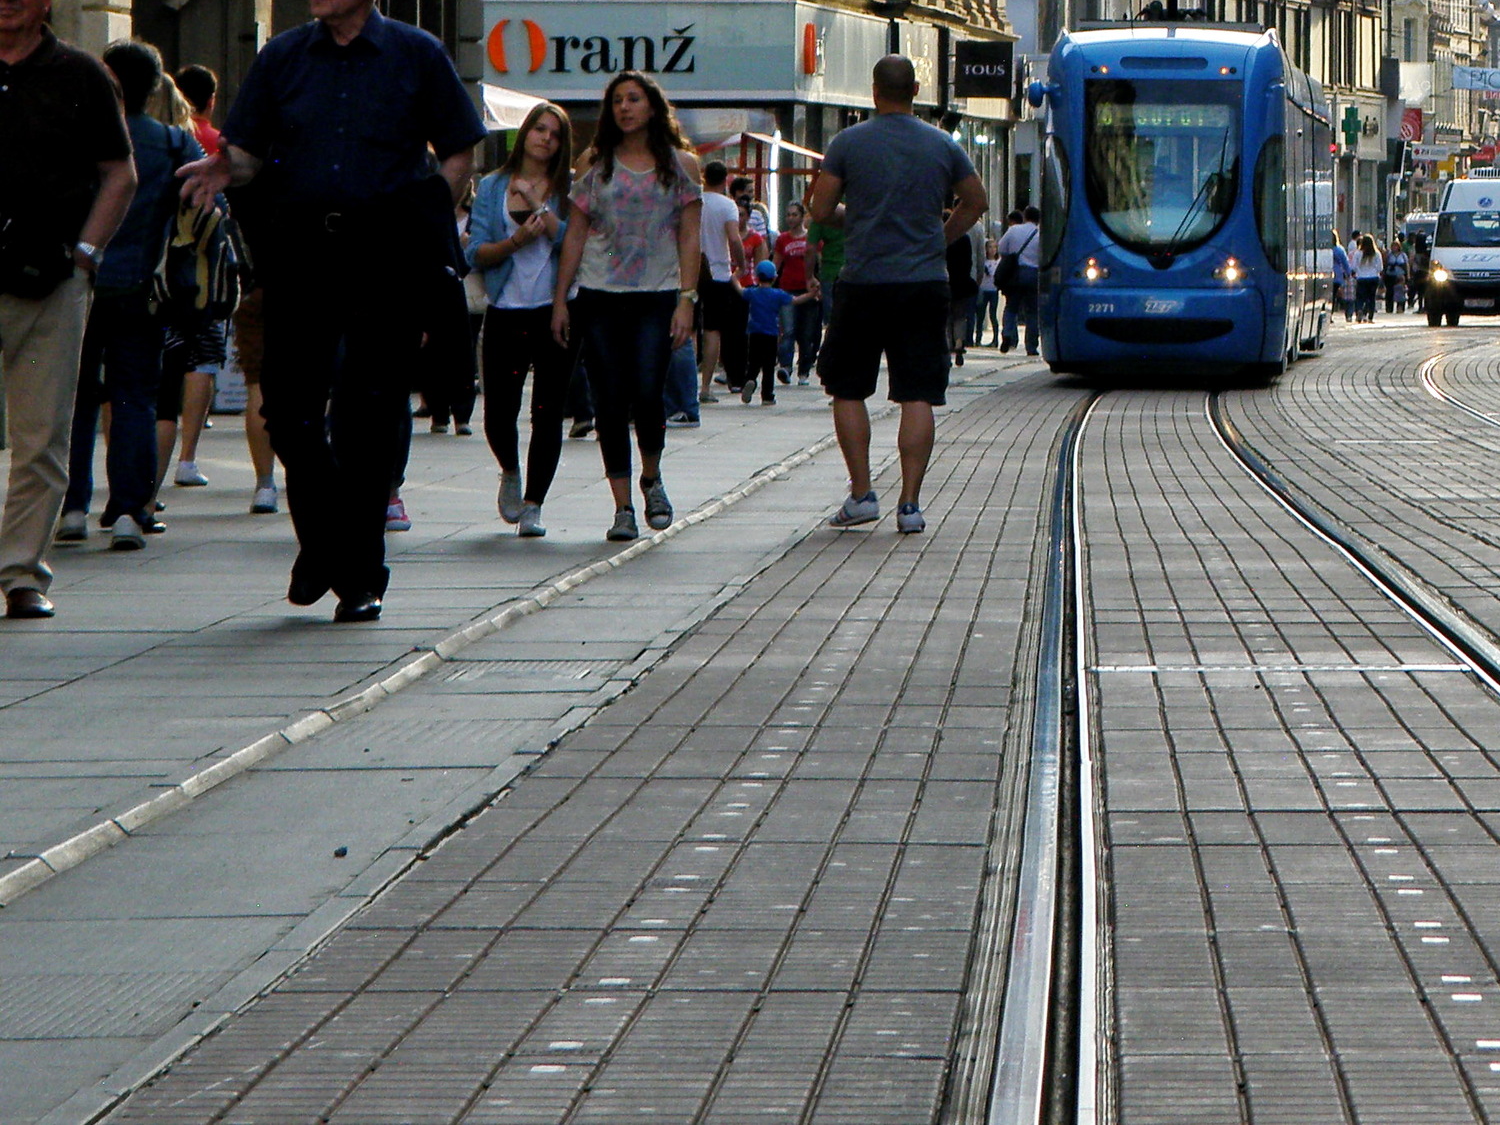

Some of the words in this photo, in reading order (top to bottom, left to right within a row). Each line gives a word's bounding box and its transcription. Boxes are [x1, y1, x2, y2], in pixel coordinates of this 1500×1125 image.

[487, 18, 696, 75] Oranž
[963, 63, 1006, 76] TOUS
[1088, 303, 1115, 313] 2271
